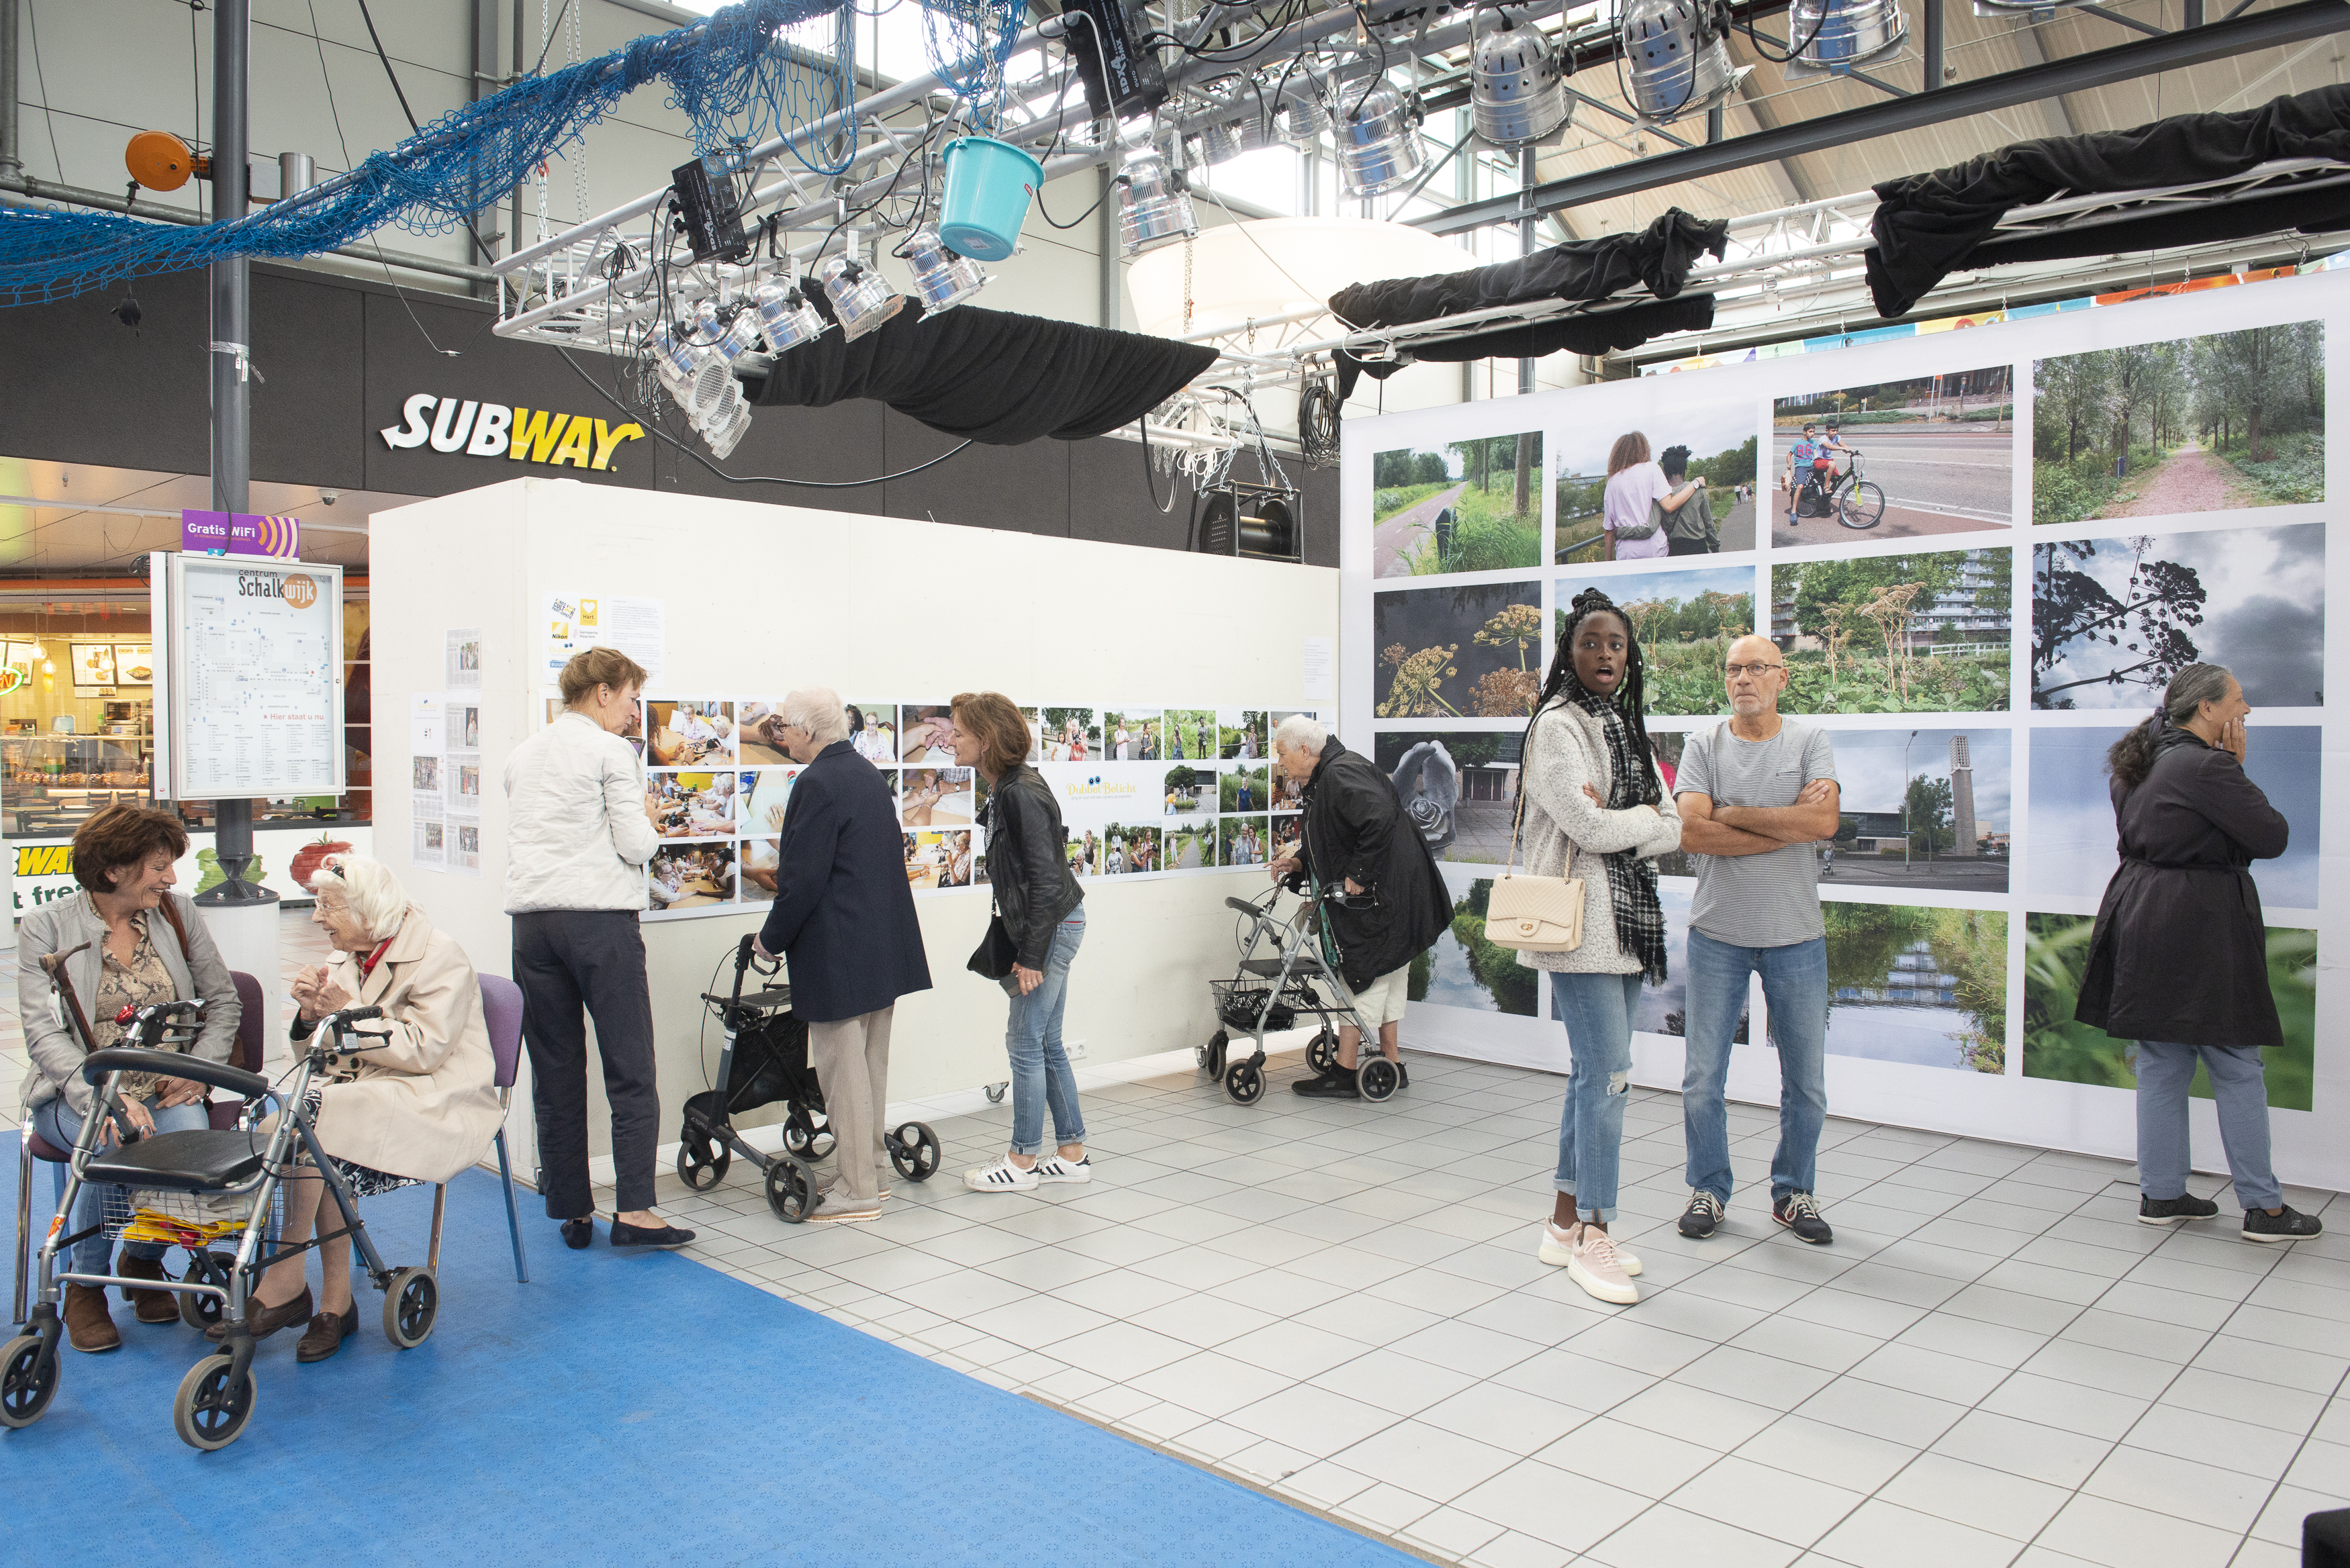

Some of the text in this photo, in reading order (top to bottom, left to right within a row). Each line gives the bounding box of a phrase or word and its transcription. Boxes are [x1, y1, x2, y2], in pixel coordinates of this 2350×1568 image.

[380, 393, 645, 471] SUBWAY
[1796, 443, 1813, 457] 86
[187, 522, 256, 538] Gratis WiFi
[238, 569, 278, 578] centrum
[238, 575, 314, 604] Schalkwijk
[547, 646, 573, 654] Dubbel
[1066, 782, 1137, 795] Dubbel Belicht
